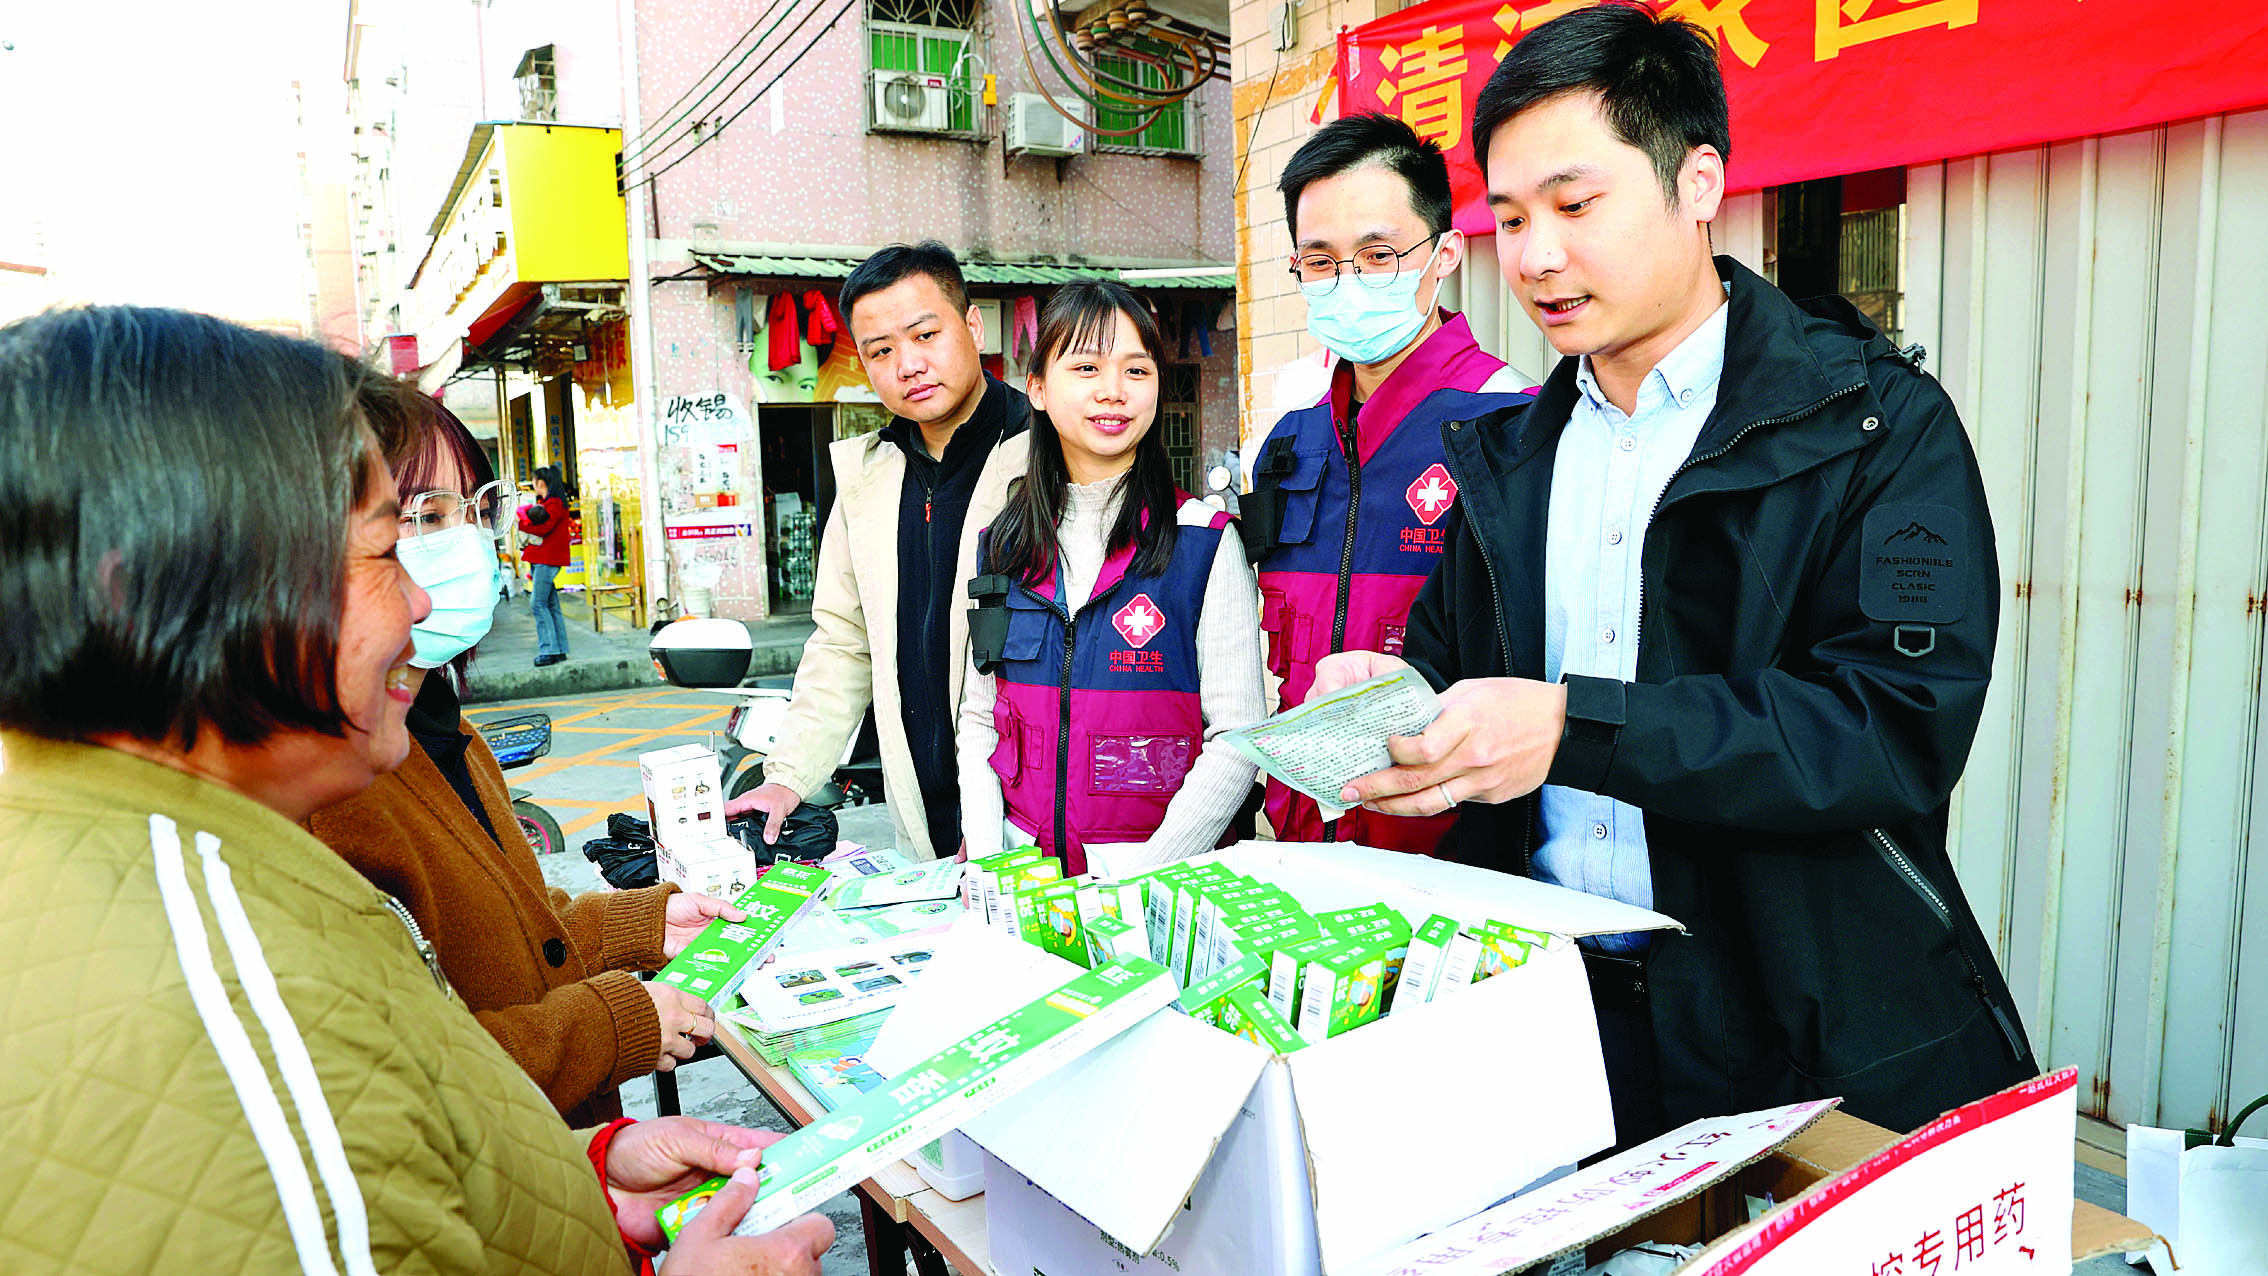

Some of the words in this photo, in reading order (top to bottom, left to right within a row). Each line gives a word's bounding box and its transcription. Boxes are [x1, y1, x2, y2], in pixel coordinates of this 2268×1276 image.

[1400, 526, 1445, 544] 中国卫
[1399, 544, 1421, 552] CHINA
[1896, 569, 1930, 578] SCRN
[1891, 582, 1936, 591] CLASIC
[1109, 649, 1164, 666] 中国卫生
[1109, 665, 1132, 673] CHINA
[1135, 665, 1164, 673] HEALTH
[719, 900, 781, 944] 蚊香
[889, 1028, 1021, 1107] 蚊香
